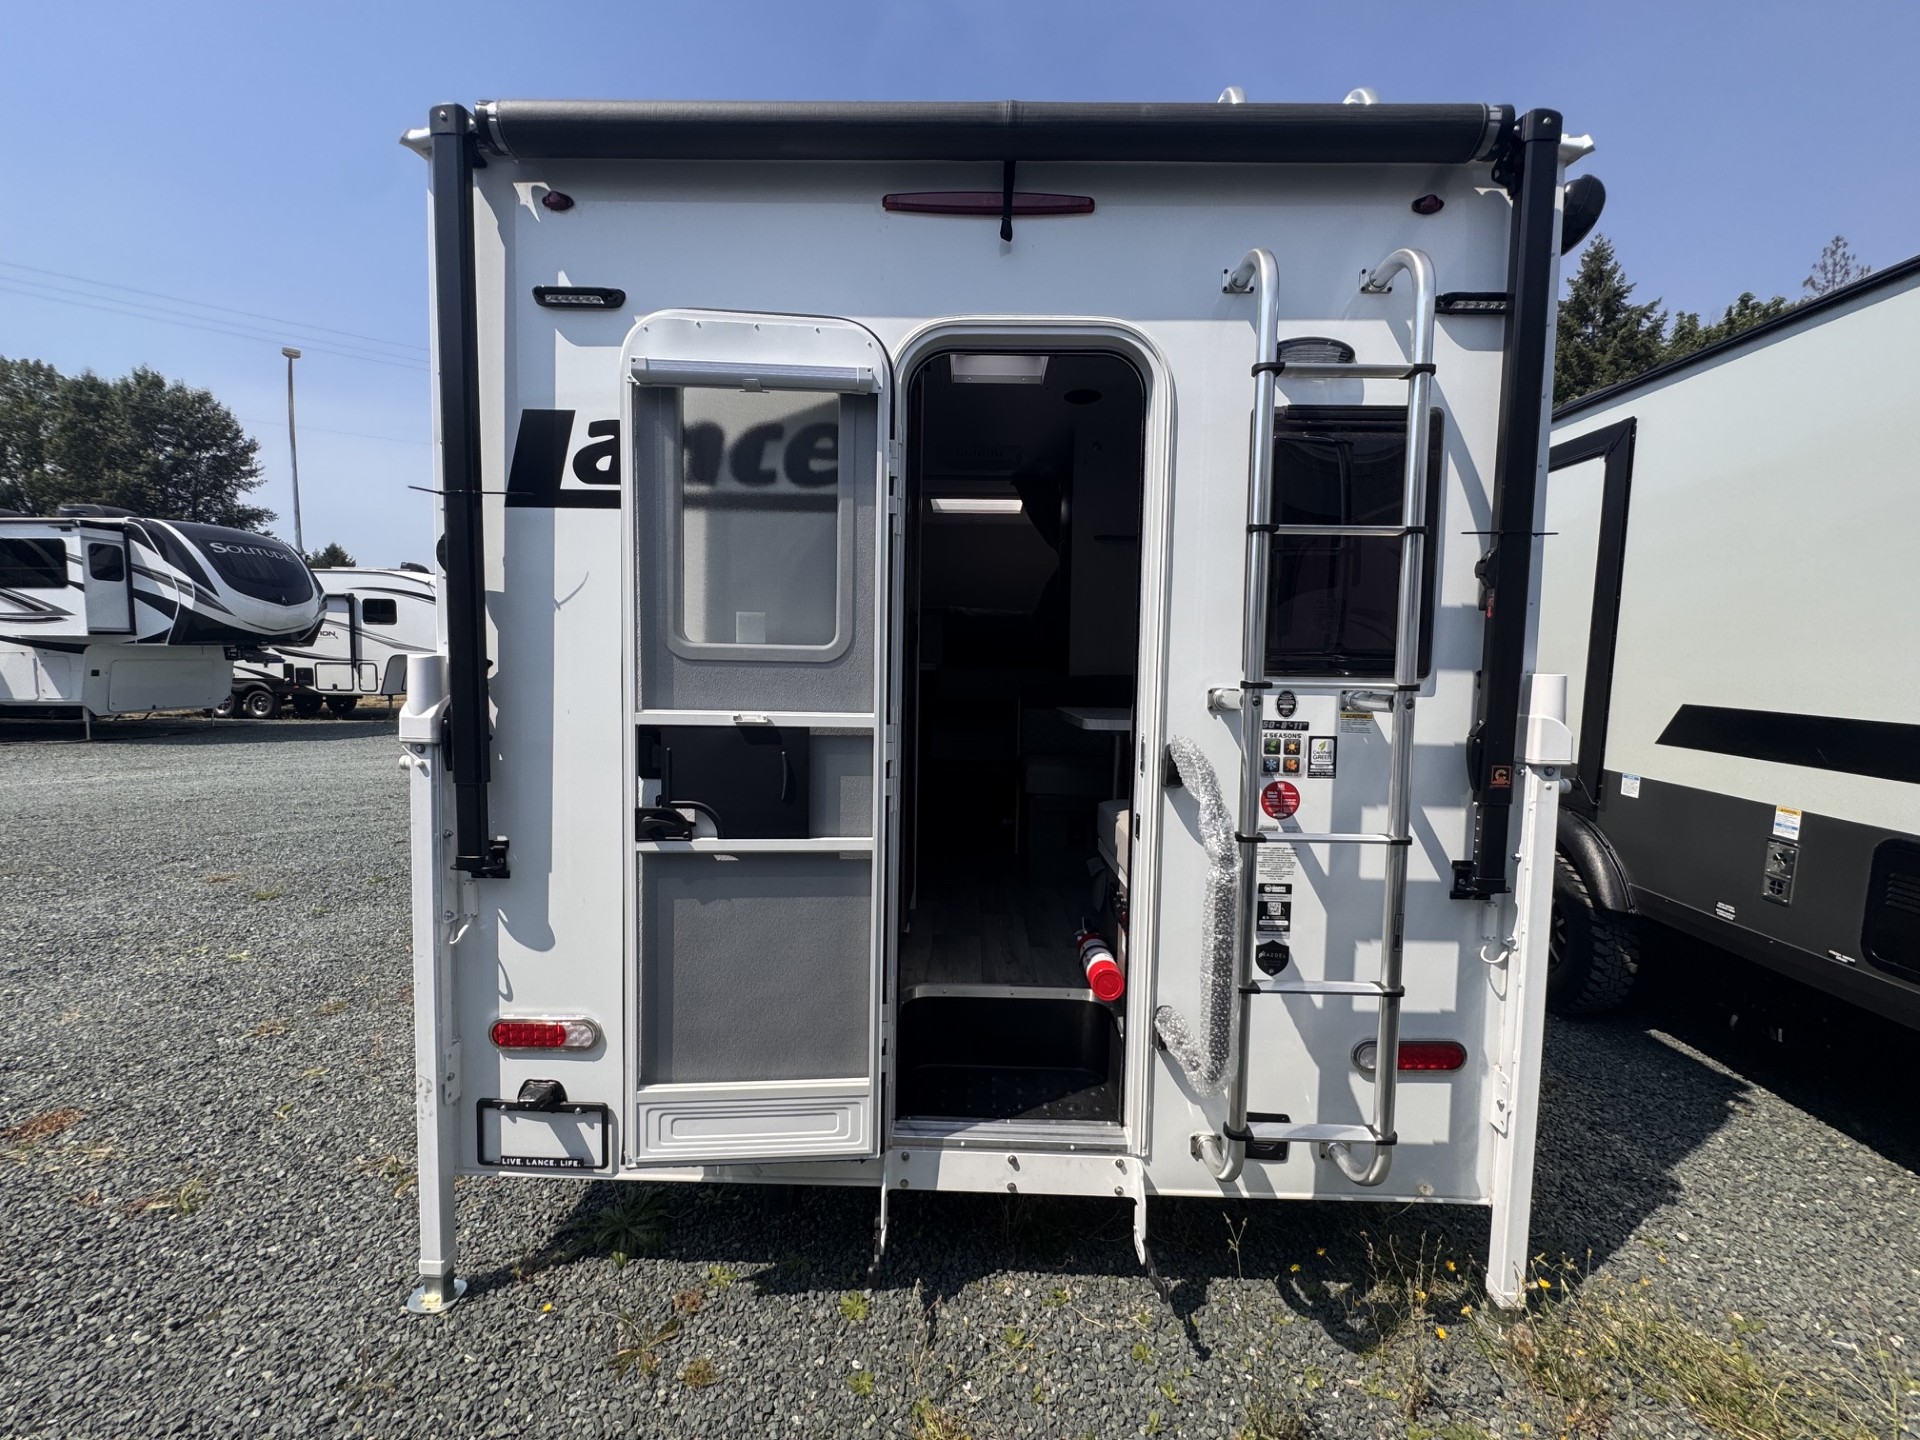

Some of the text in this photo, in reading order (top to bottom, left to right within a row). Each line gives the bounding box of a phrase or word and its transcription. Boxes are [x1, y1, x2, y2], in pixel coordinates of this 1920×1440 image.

[209, 542, 294, 563] SOLITUDE
[502, 1157, 581, 1168] LIVE. LANCE. LIFE.
